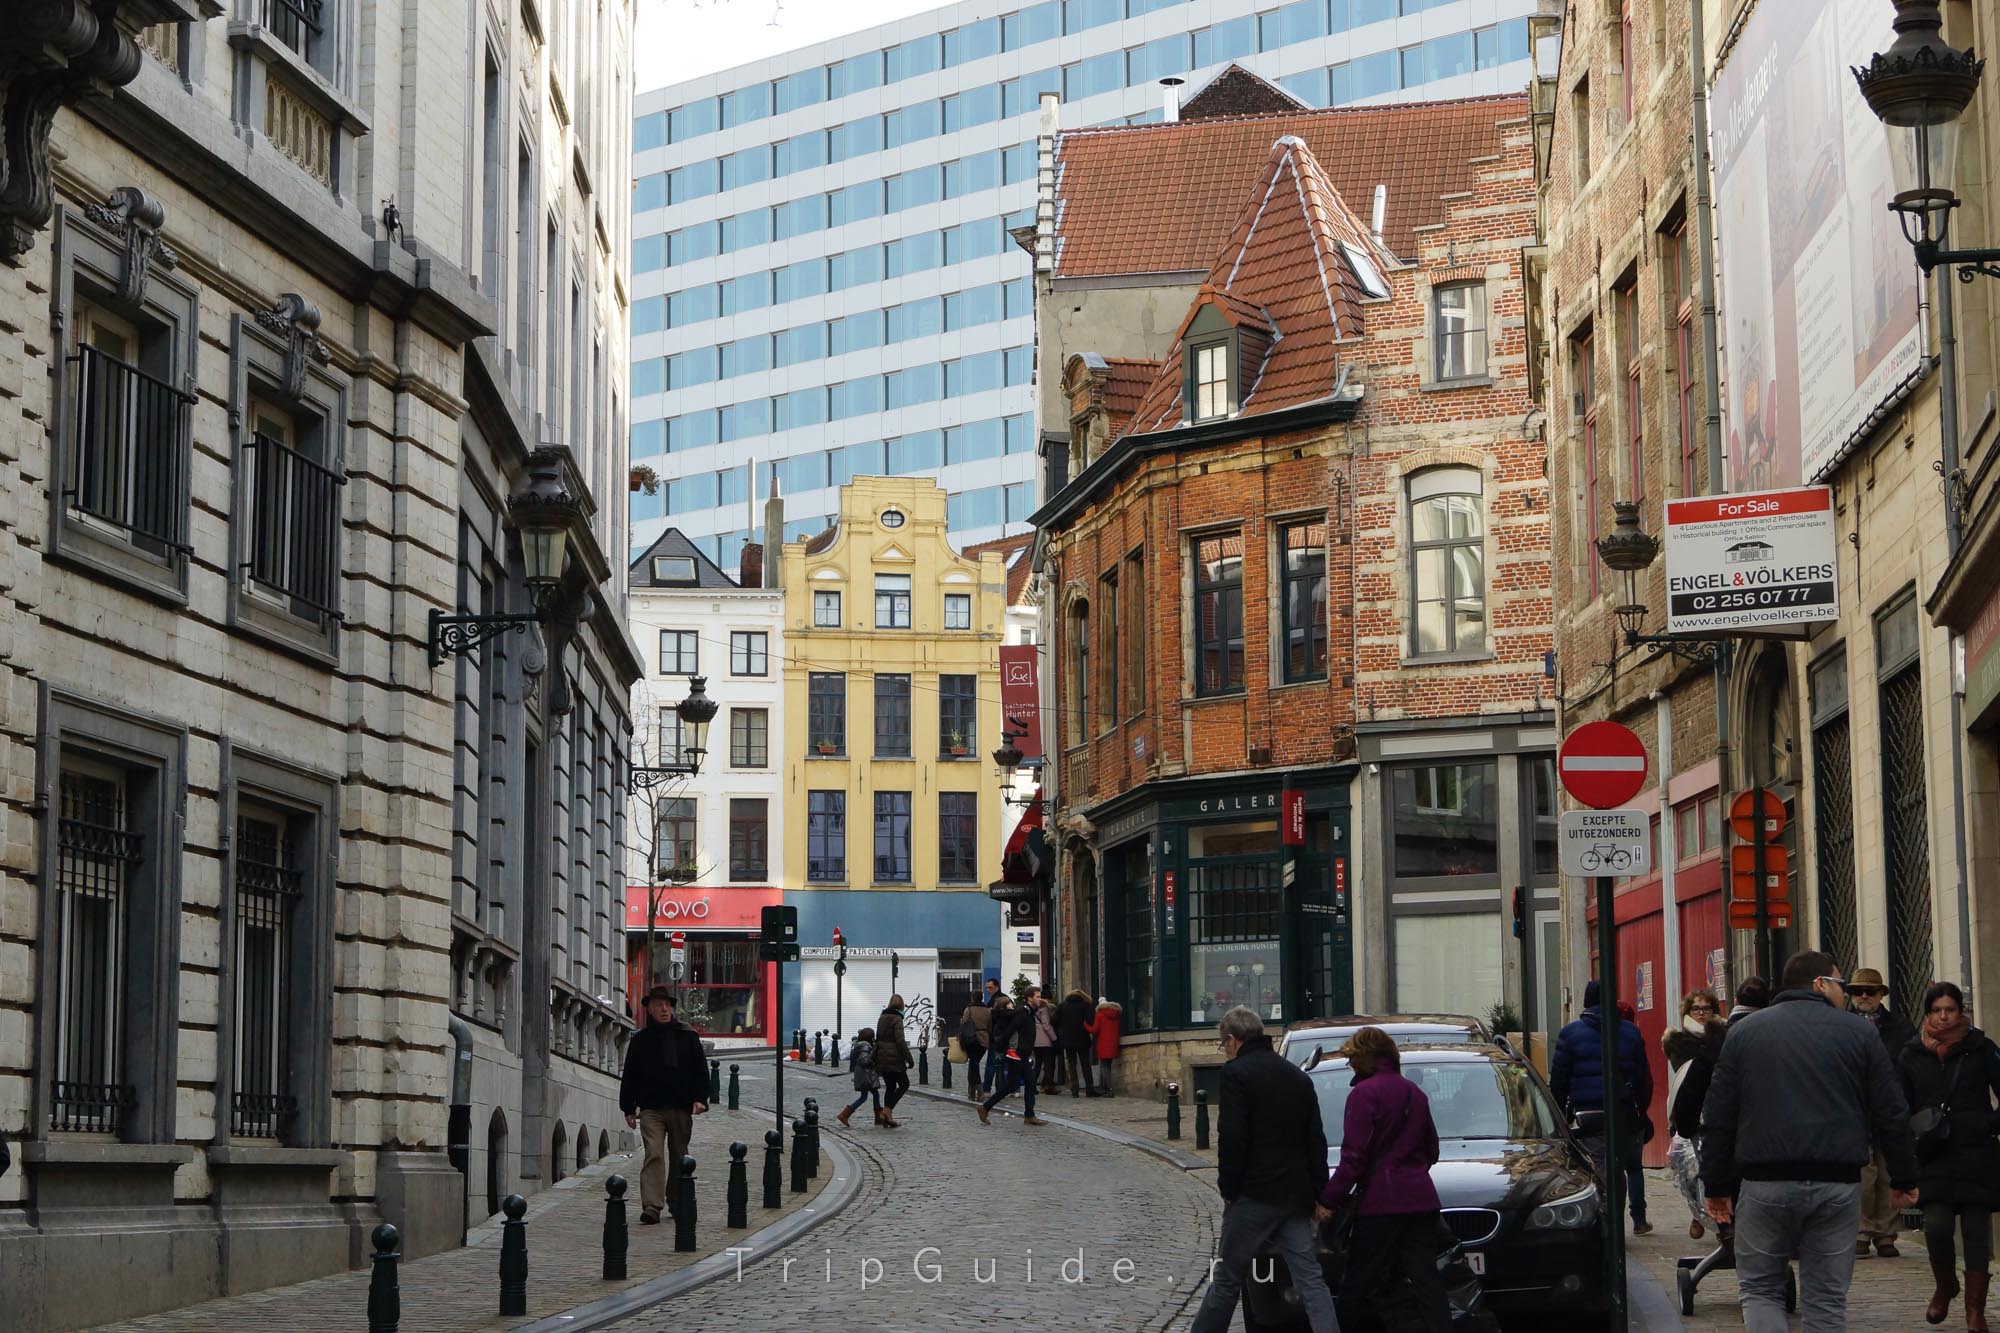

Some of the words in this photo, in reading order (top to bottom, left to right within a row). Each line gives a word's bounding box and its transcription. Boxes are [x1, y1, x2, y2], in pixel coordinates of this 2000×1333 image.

[1717, 128, 1728, 174] De
[1718, 502, 1745, 516] For
[1746, 499, 1779, 513] Sale
[1680, 530, 1711, 539] Historical
[1711, 529, 1737, 537] building
[1807, 520, 1827, 529] space
[1685, 522, 1718, 531] Luxurious
[1719, 517, 1758, 529] Apartments
[1758, 516, 1771, 524] and
[1778, 513, 1817, 522] Penthouses
[1693, 595, 1716, 610] 02
[1720, 592, 1756, 608] 256
[1759, 590, 1783, 604] 07
[1787, 587, 1811, 602] 77
[1672, 606, 1835, 628] www.engelvoelkers.be
[1005, 709, 1037, 718] Hunter
[1200, 794, 1276, 812] GALER
[1582, 815, 1626, 826] EXCEPTE
[1568, 827, 1641, 839] UITGEZONDERD
[646, 900, 709, 919] NOVO
